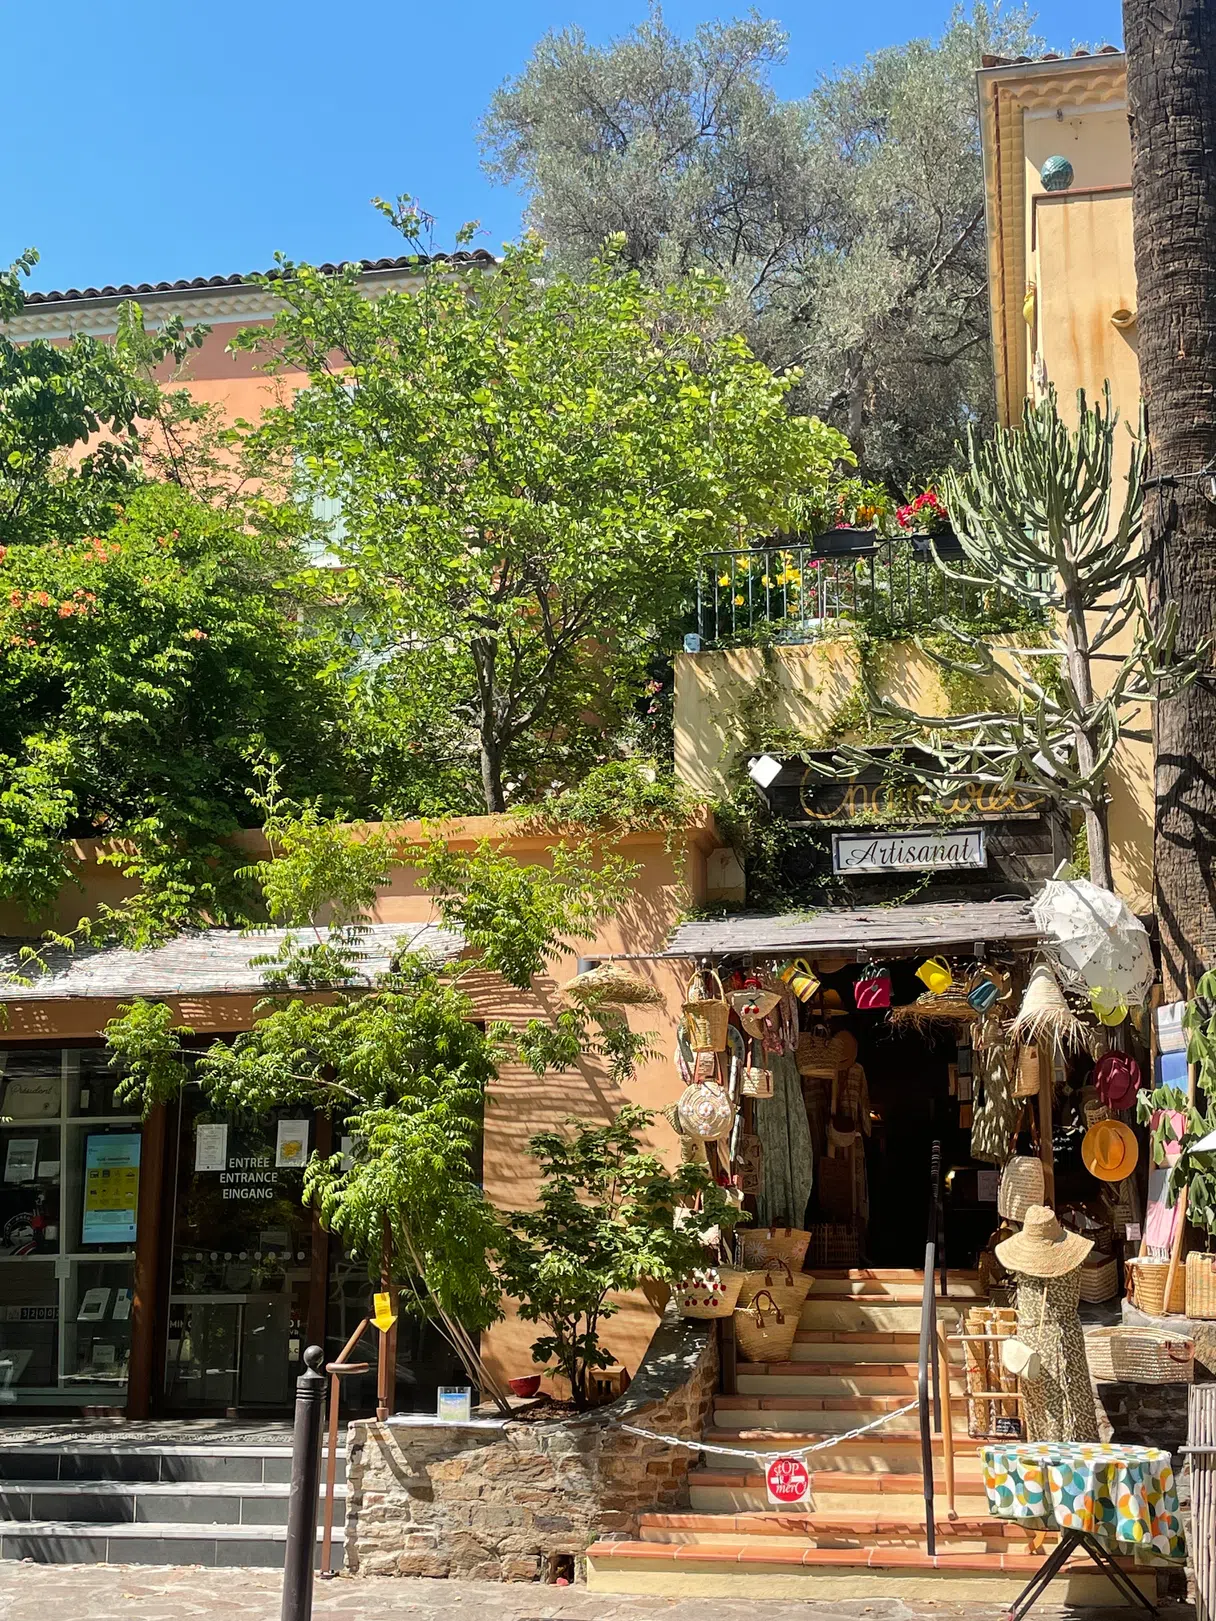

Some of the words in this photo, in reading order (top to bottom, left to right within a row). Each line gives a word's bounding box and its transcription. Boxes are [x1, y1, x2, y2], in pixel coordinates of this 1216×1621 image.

[845, 837, 973, 866] Artisanat
[219, 1172, 278, 1183] ENTRANCE
[222, 1188, 273, 1199] EINGANG
